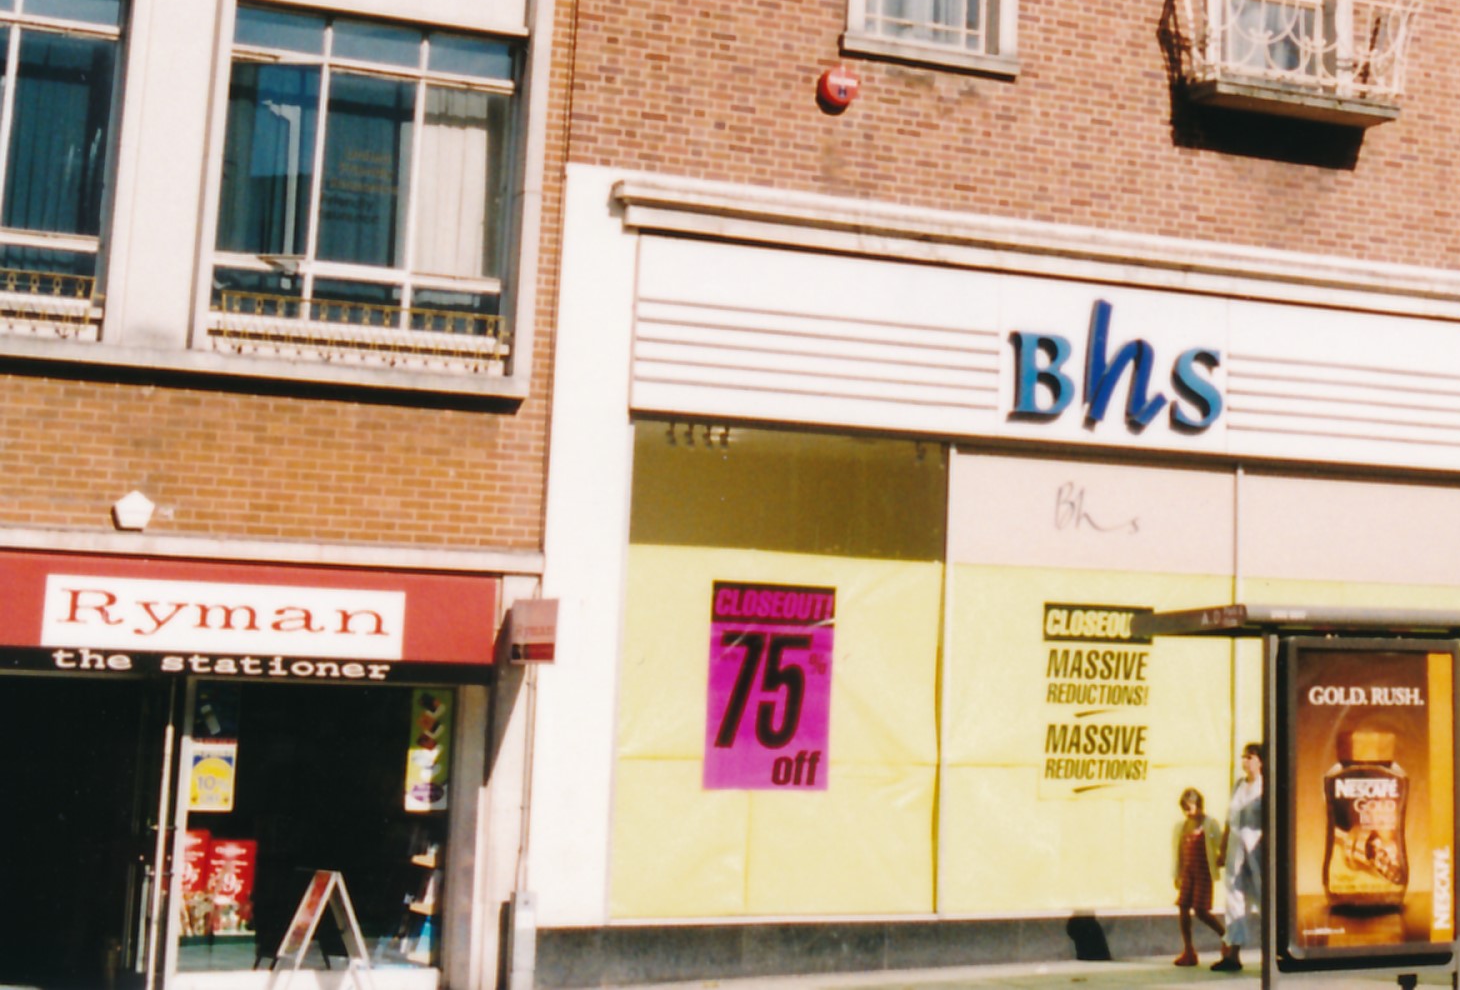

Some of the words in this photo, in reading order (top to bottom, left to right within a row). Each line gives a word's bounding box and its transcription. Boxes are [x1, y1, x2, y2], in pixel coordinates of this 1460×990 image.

[56, 588, 390, 635] Ryman
[714, 588, 834, 621] CLOSEOUT!
[52, 648, 133, 670] the
[160, 653, 392, 680] stationer
[1046, 649, 1149, 681] MASSIVE
[1046, 683, 1149, 707] REDUCTIONS!
[1308, 685, 1369, 706] GOLD.
[1371, 687, 1425, 706] RUSH.
[1044, 724, 1149, 755] MASSIVE
[771, 750, 821, 787] off
[1044, 758, 1148, 782] REDUCTIONS!
